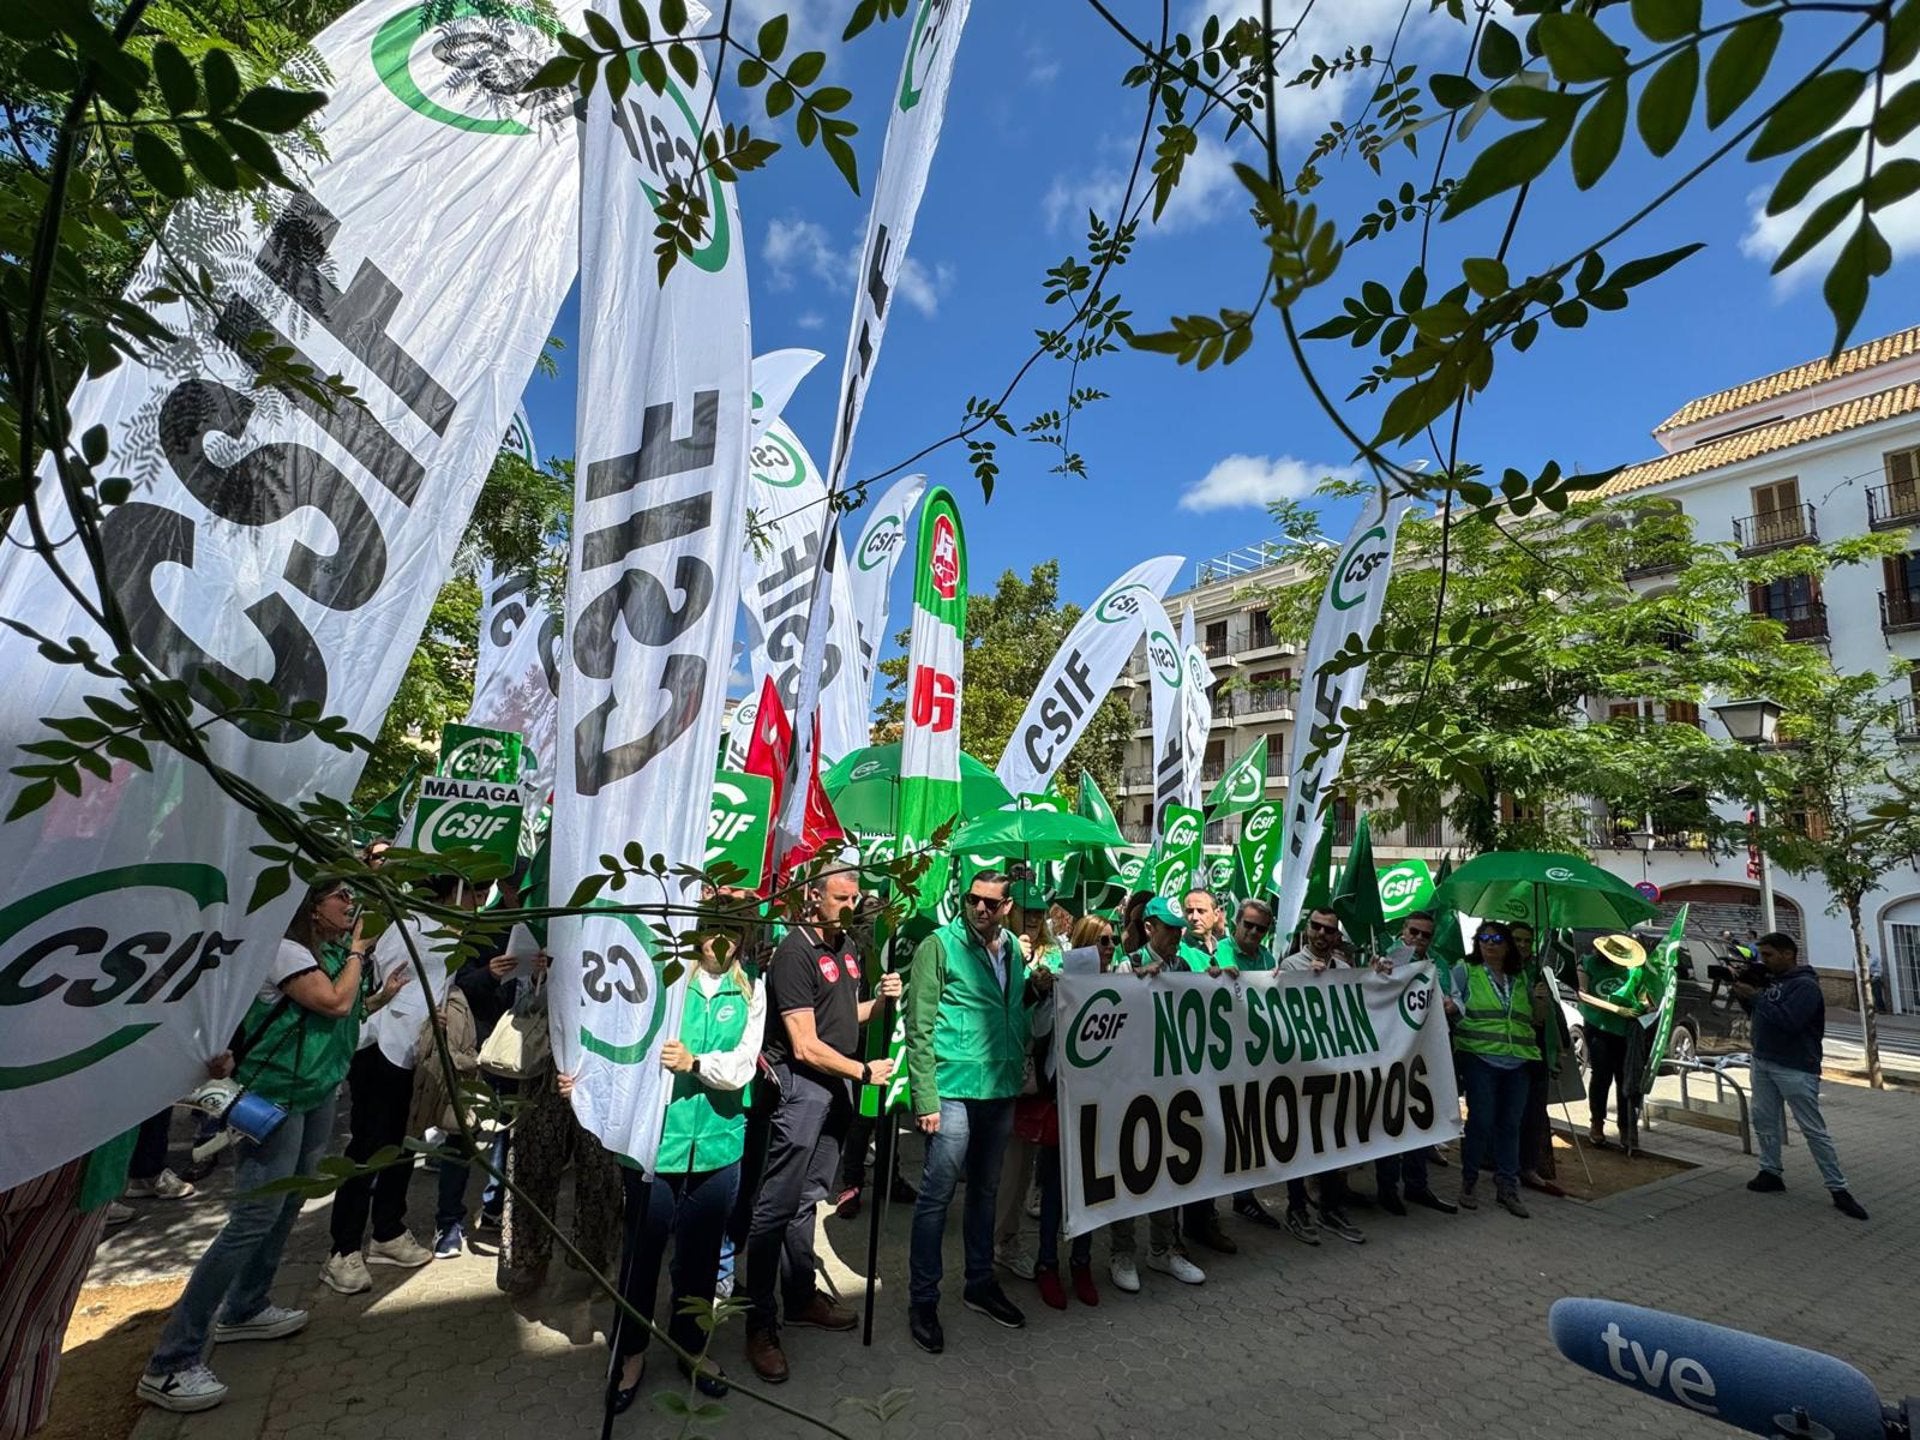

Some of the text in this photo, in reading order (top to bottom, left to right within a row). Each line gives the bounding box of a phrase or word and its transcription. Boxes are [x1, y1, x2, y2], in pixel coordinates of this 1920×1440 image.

[101, 186, 458, 743] CSIF
[1024, 648, 1095, 775] CSIF
[455, 752, 510, 775] CSIF
[424, 780, 520, 803] MÁLAGA
[437, 812, 510, 840] CSIF
[707, 808, 757, 843] SIF
[1172, 827, 1200, 848] CSIF
[1252, 815, 1277, 830] CSIF
[1383, 878, 1423, 898] CSIF
[0, 926, 245, 1007] CSIF
[1079, 1011, 1129, 1042] CSIF
[1152, 982, 1380, 1078] NOS SOBRAN
[1079, 1053, 1435, 1208] LOS MOTIVOS
[1601, 1321, 1720, 1415] tve
